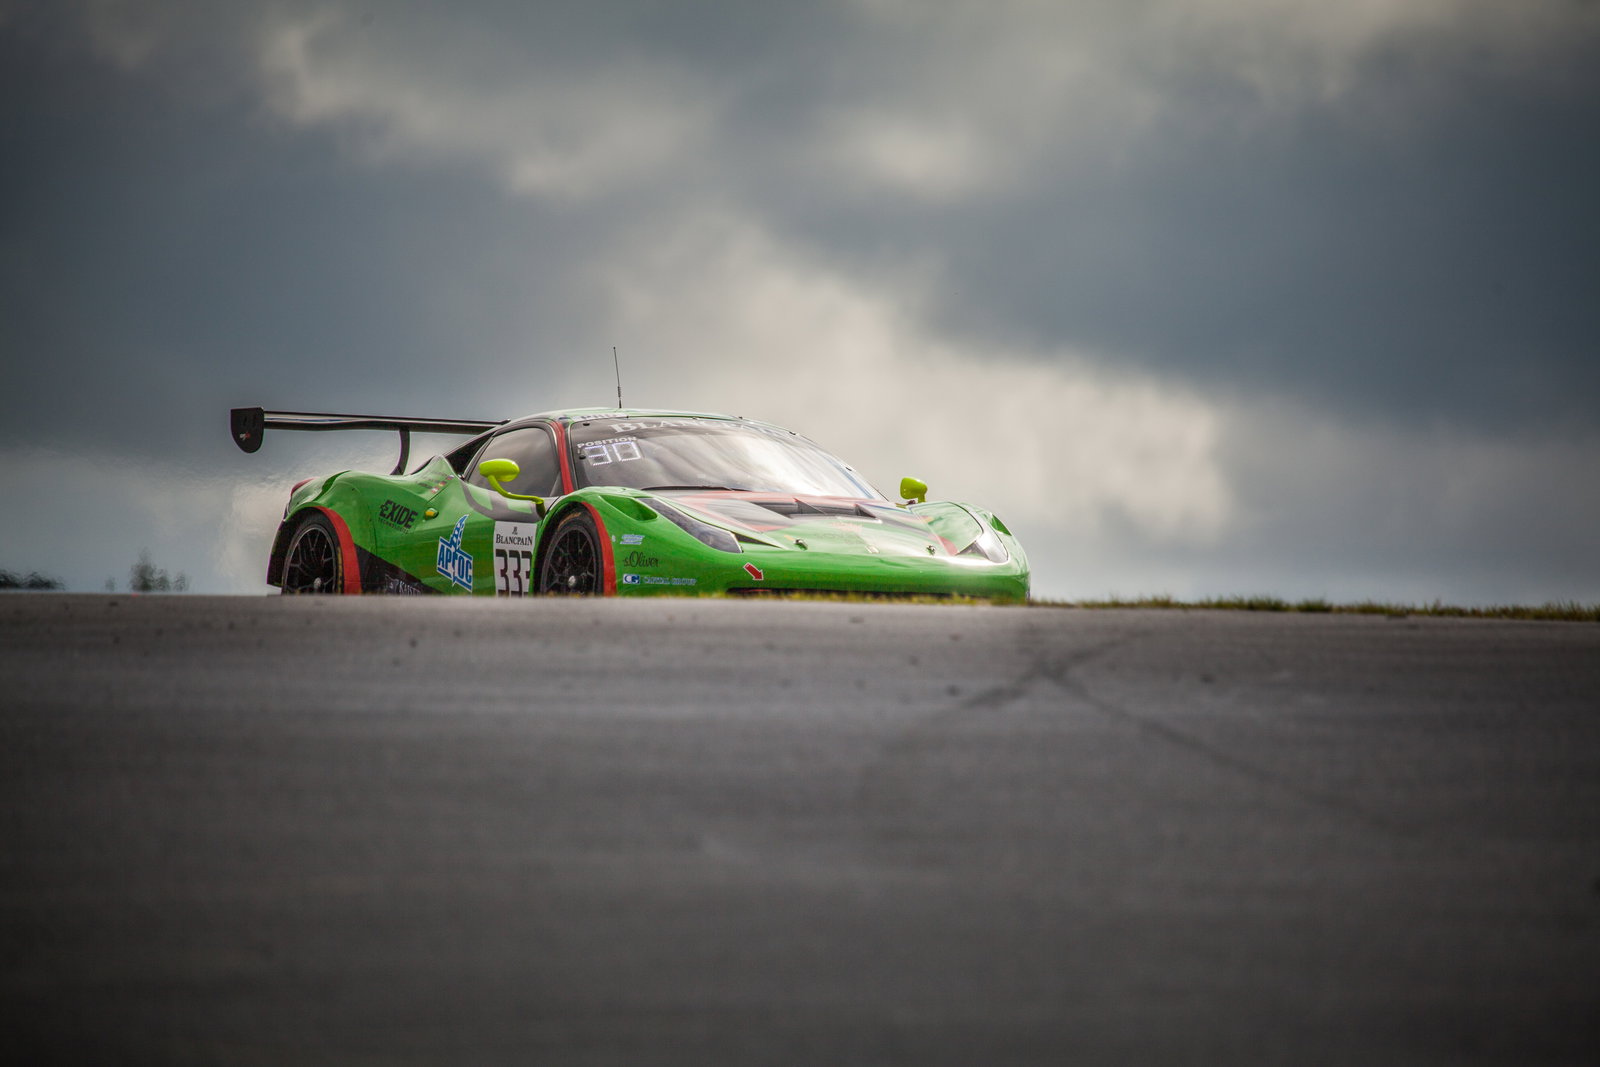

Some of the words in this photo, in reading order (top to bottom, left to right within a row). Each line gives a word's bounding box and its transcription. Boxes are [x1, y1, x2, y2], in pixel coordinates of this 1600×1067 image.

[577, 436, 637, 448] POSITION
[379, 499, 418, 528] EXIDE
[495, 533, 533, 546] BLANCPAIN
